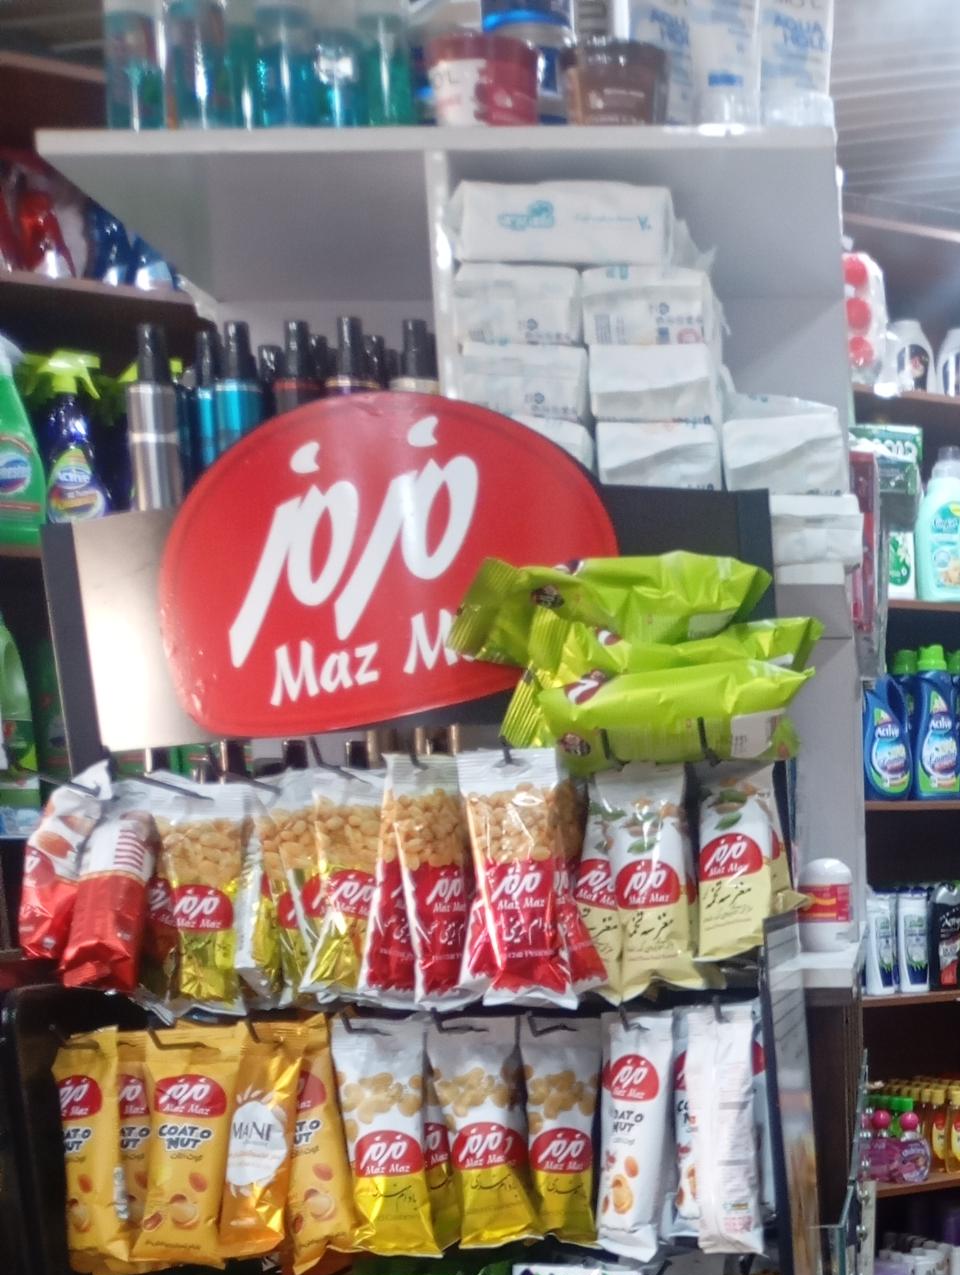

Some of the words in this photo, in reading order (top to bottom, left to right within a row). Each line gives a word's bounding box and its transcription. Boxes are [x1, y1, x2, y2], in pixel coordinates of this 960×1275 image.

[228, 415, 480, 668] مزمز
[270, 639, 380, 707] Maz
[166, 1137, 201, 1150] NUT
